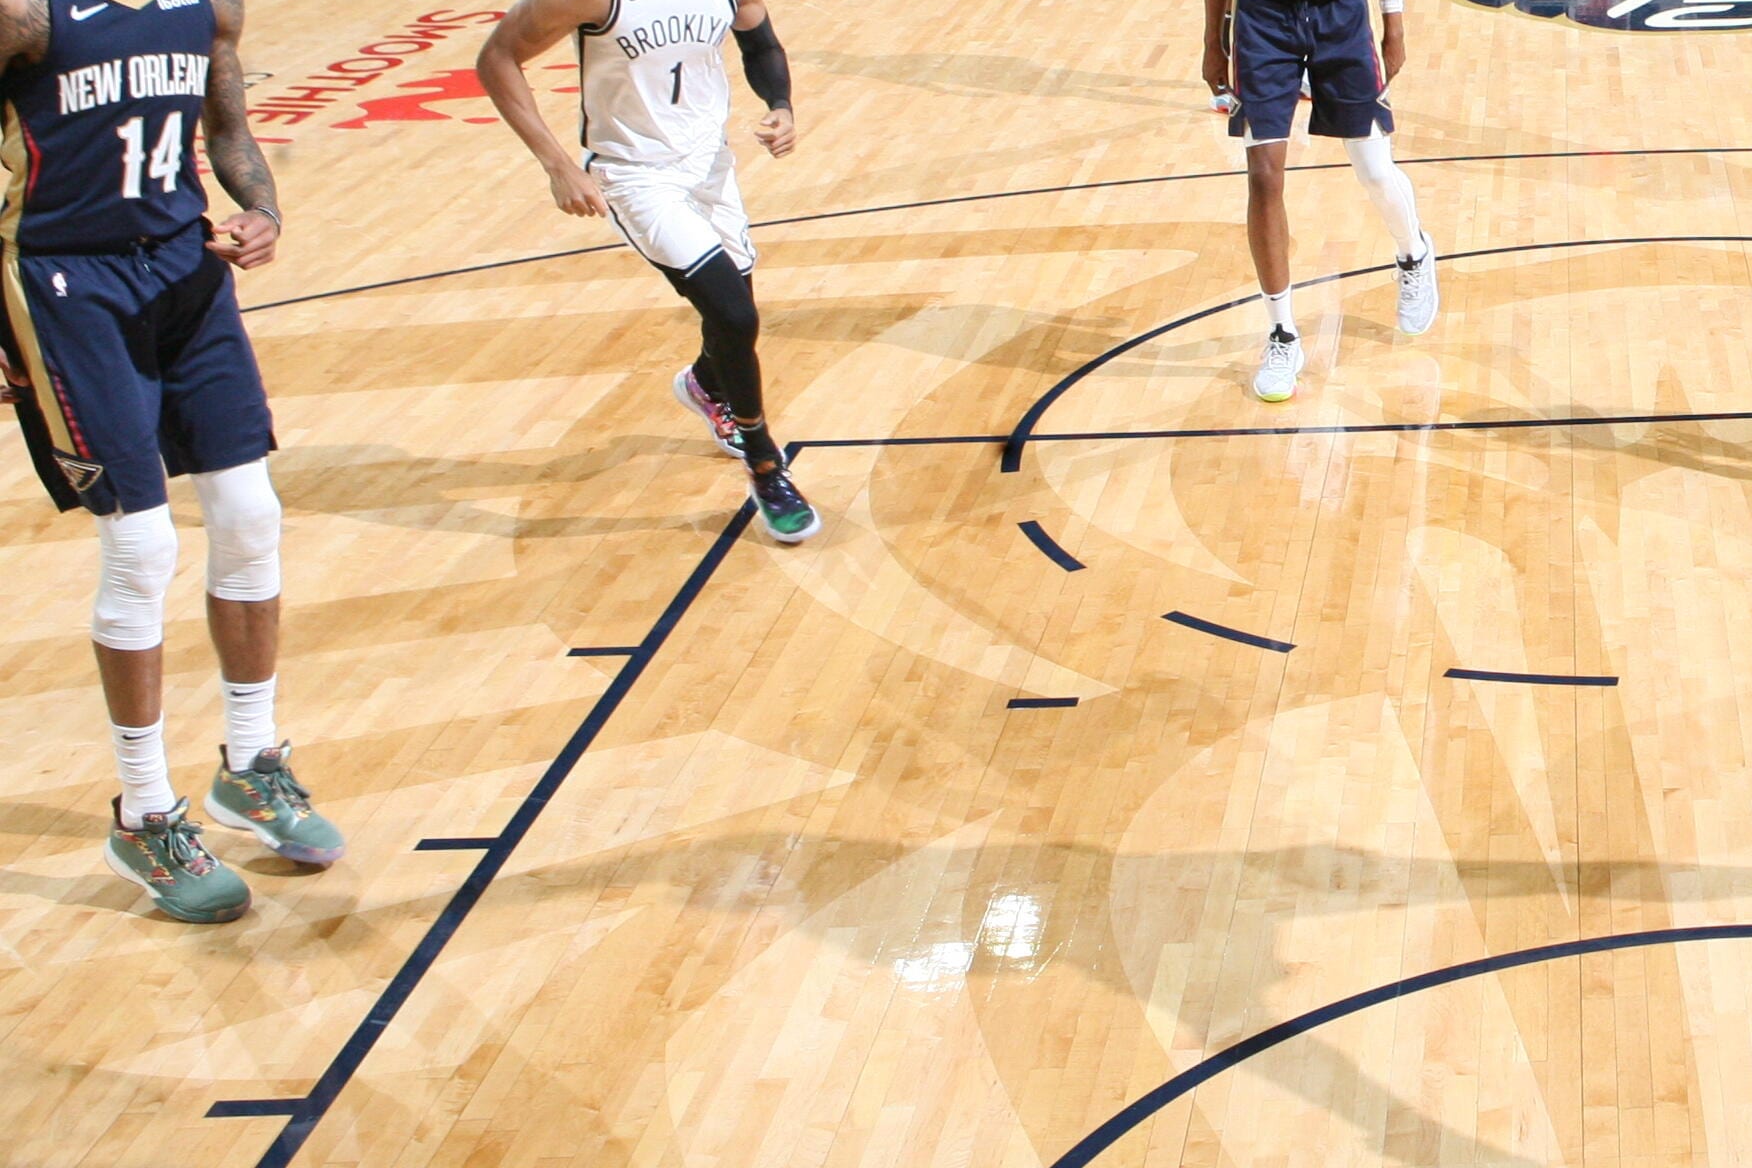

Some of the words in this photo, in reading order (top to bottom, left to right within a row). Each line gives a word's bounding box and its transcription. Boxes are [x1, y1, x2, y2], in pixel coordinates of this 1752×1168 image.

[57, 59, 122, 115] NEW
[128, 53, 210, 99] ORLEAN
[669, 61, 684, 105] 1
[116, 111, 183, 199] 14
